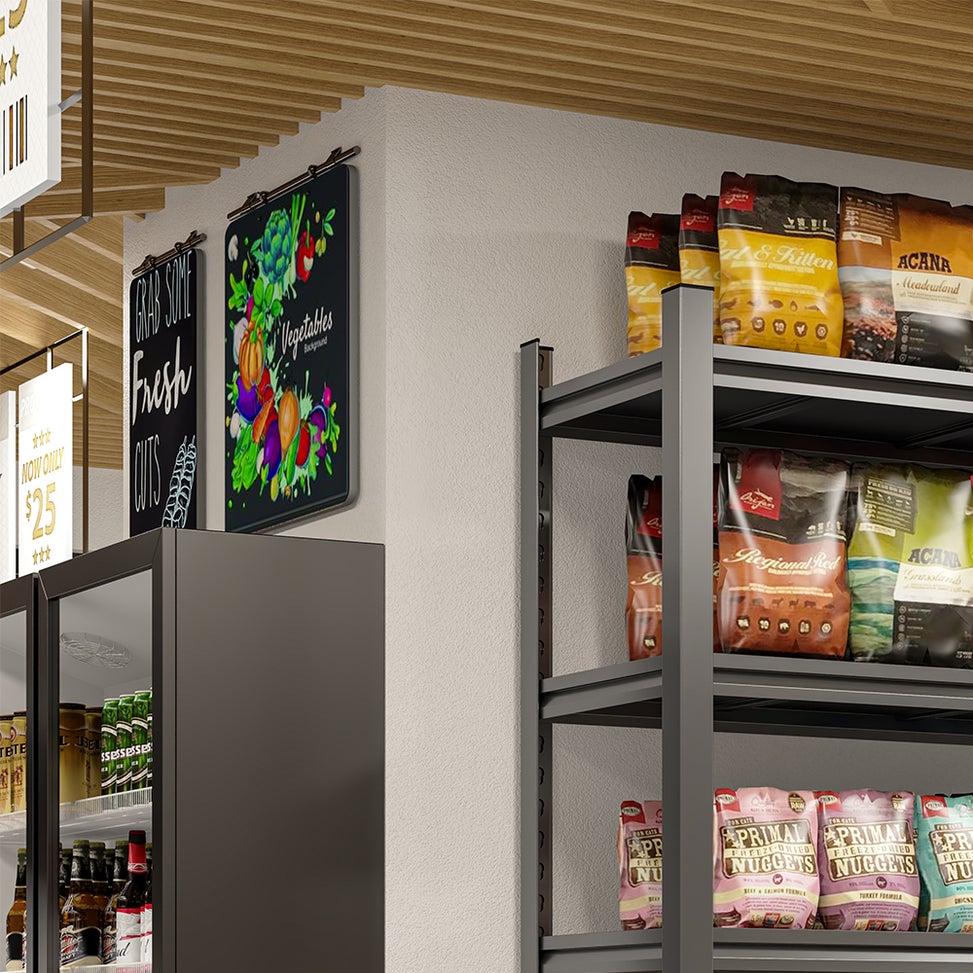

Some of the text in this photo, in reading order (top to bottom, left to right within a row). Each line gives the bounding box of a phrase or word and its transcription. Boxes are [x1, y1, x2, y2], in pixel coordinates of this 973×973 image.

[773, 244, 834, 270] Kitten
[897, 251, 953, 274] ACANA
[135, 249, 193, 344] GRAB SOME
[280, 306, 334, 361] Vegetables
[303, 335, 328, 354] Background
[132, 336, 194, 426] Fresh
[21, 446, 65, 484] NOW ONLY
[134, 434, 162, 513] CUTS
[25, 482, 57, 541] $25
[810, 551, 841, 571] Red
[908, 547, 962, 568] ACANA
[737, 823, 805, 849] PRIMAL
[836, 823, 907, 847] PRIMAL
[732, 844, 813, 857] FREEZE-DRIED
[833, 846, 912, 857] FREEZE-DRIED
[731, 856, 814, 876] NUGGETS
[835, 856, 916, 878] NUGGETS
[859, 892, 903, 901] TURKEY FORMULA
